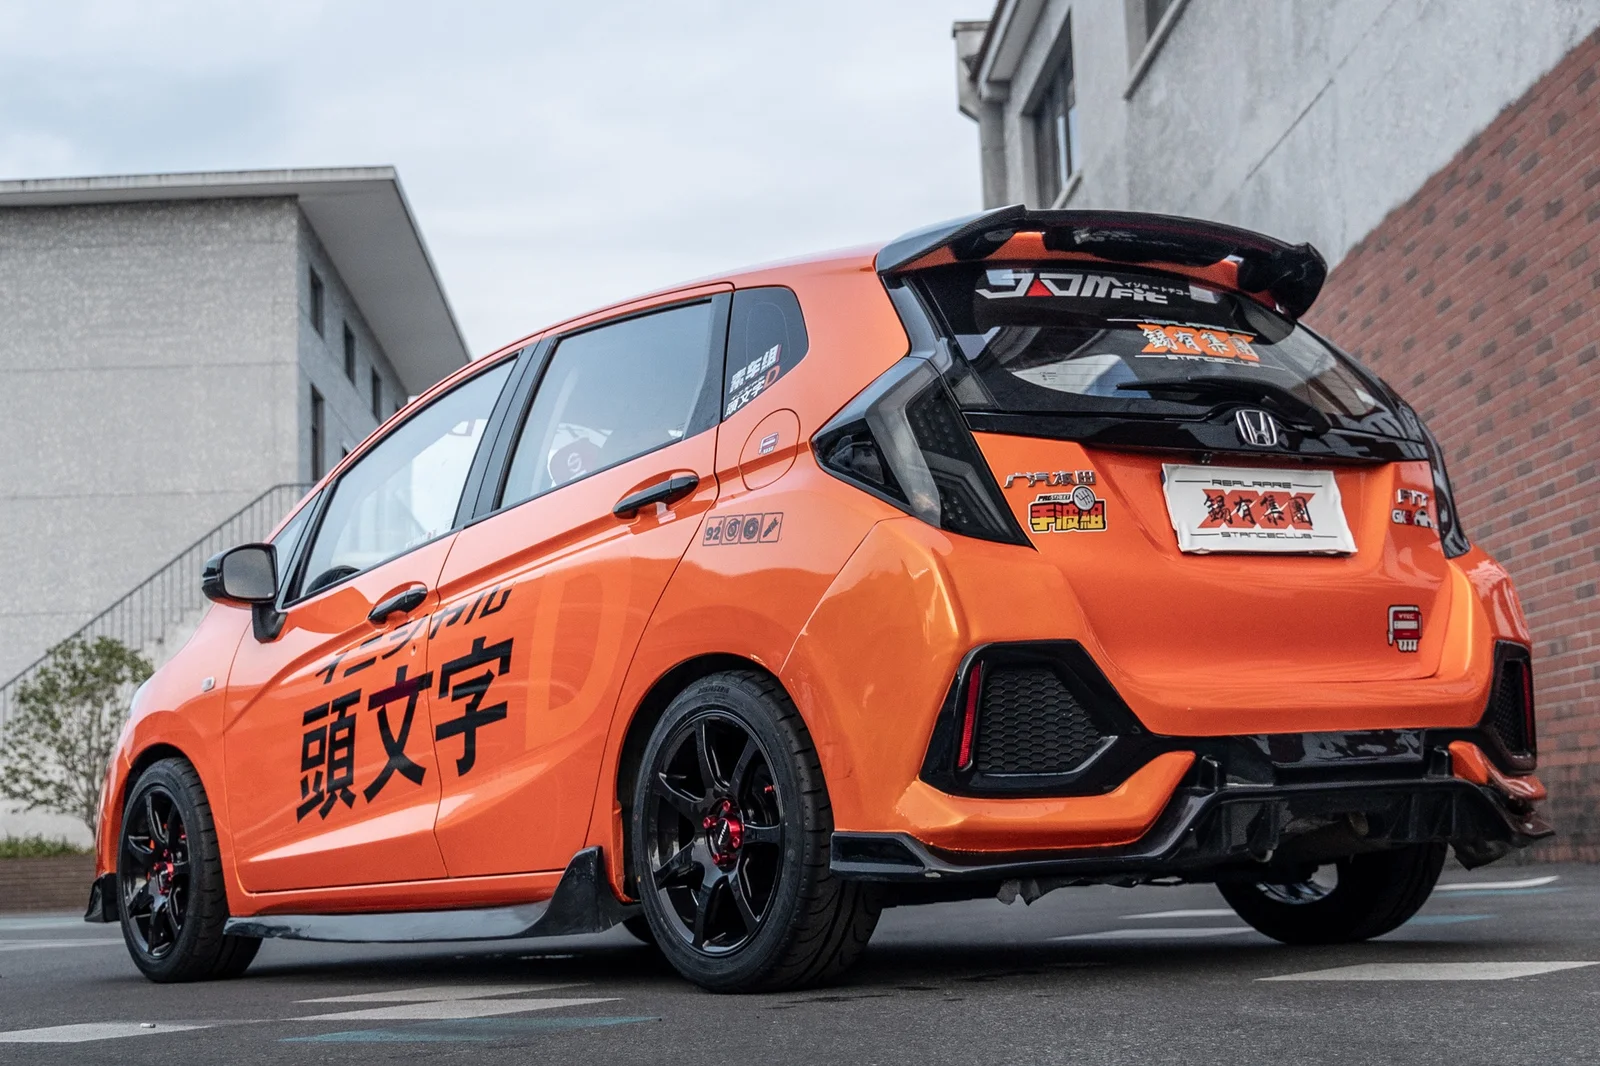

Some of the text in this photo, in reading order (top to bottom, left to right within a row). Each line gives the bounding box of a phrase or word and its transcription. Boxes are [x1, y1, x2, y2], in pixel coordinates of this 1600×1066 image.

[706, 526, 721, 541] 92
[296, 636, 514, 823] 頭文字
